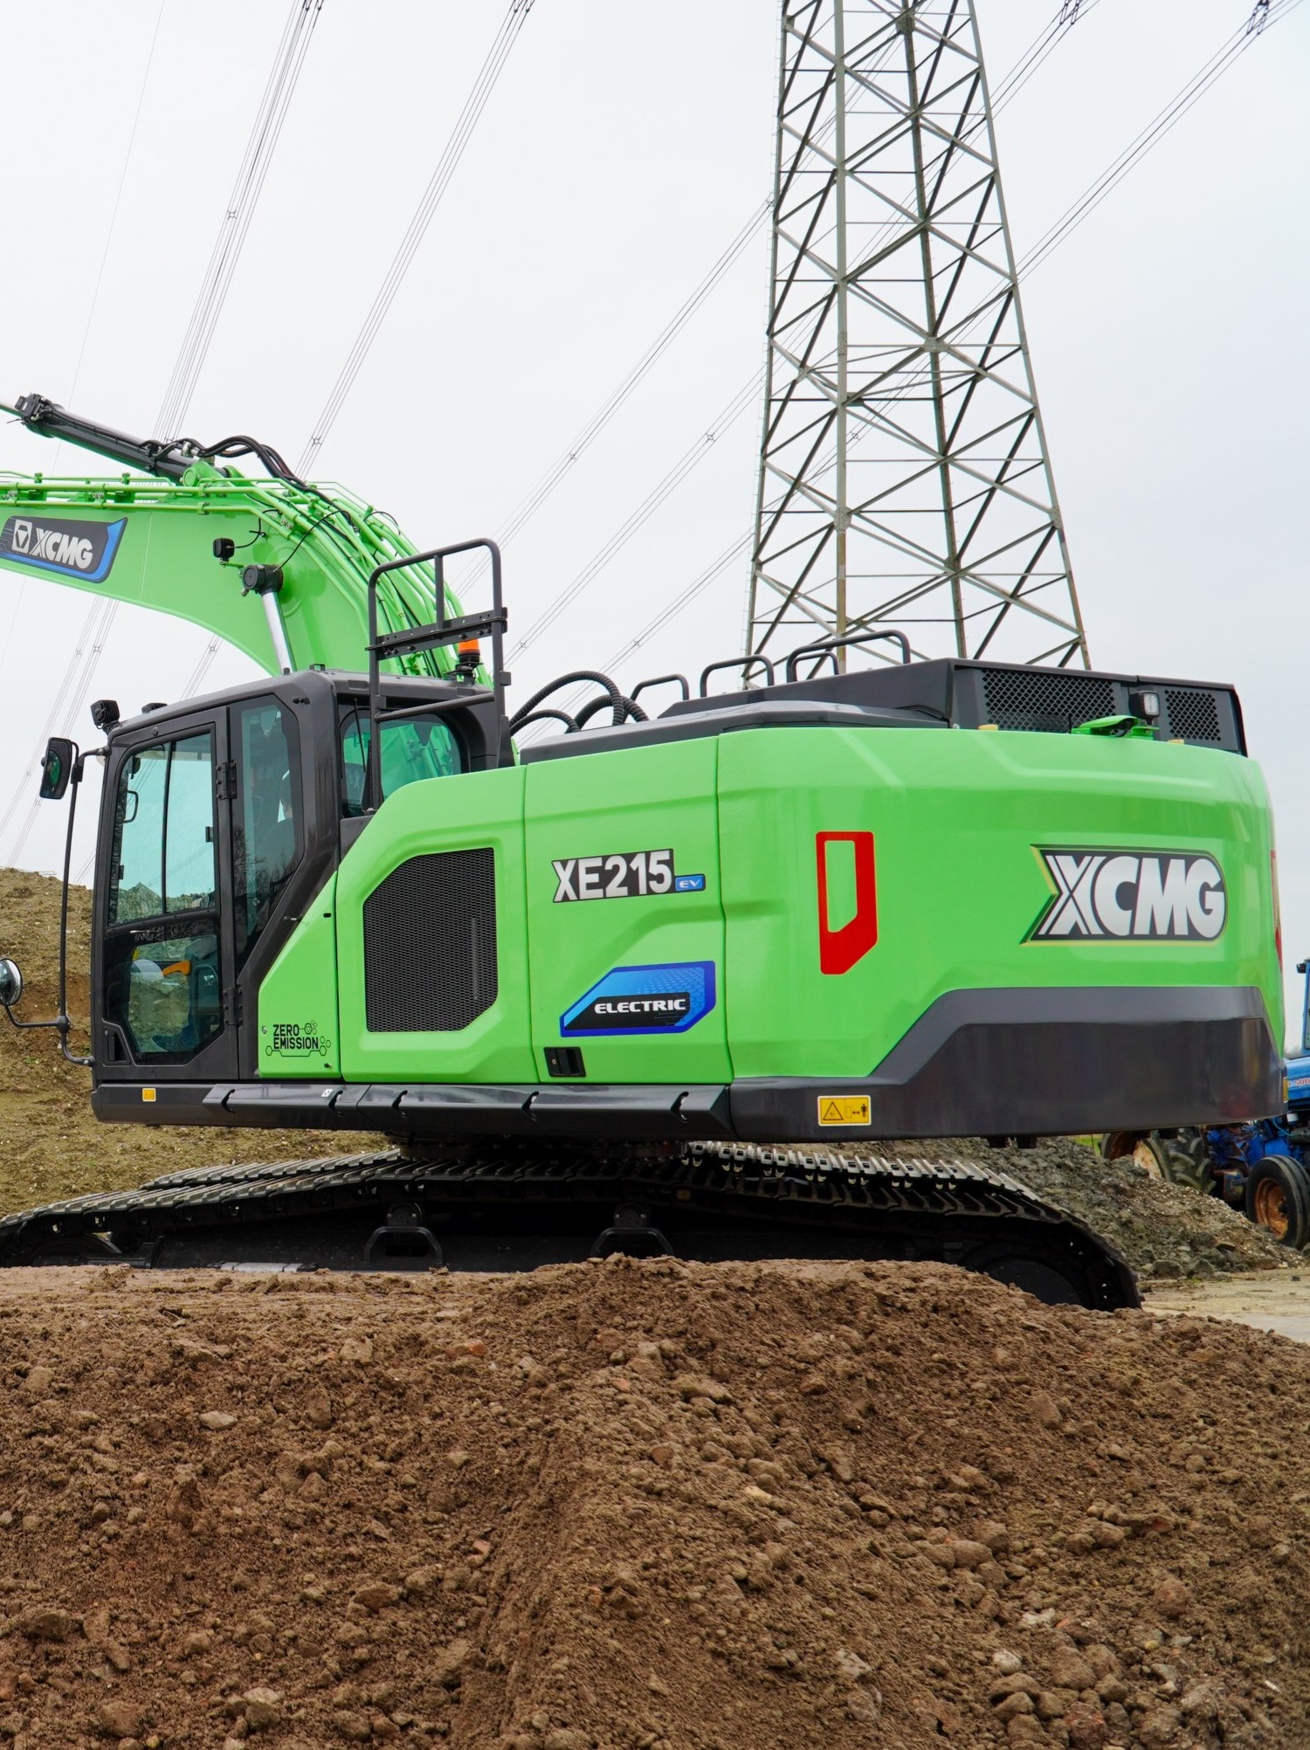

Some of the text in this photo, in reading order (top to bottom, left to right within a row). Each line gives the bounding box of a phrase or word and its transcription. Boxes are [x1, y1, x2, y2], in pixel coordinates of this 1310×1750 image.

[29, 527, 93, 569] XCMG
[552, 850, 701, 902] XE215 EV
[1038, 855, 1226, 938] XCMG
[594, 998, 686, 1015] ELECTRIC
[273, 1024, 300, 1036] ZERO
[273, 1037, 319, 1050] EMISSION
